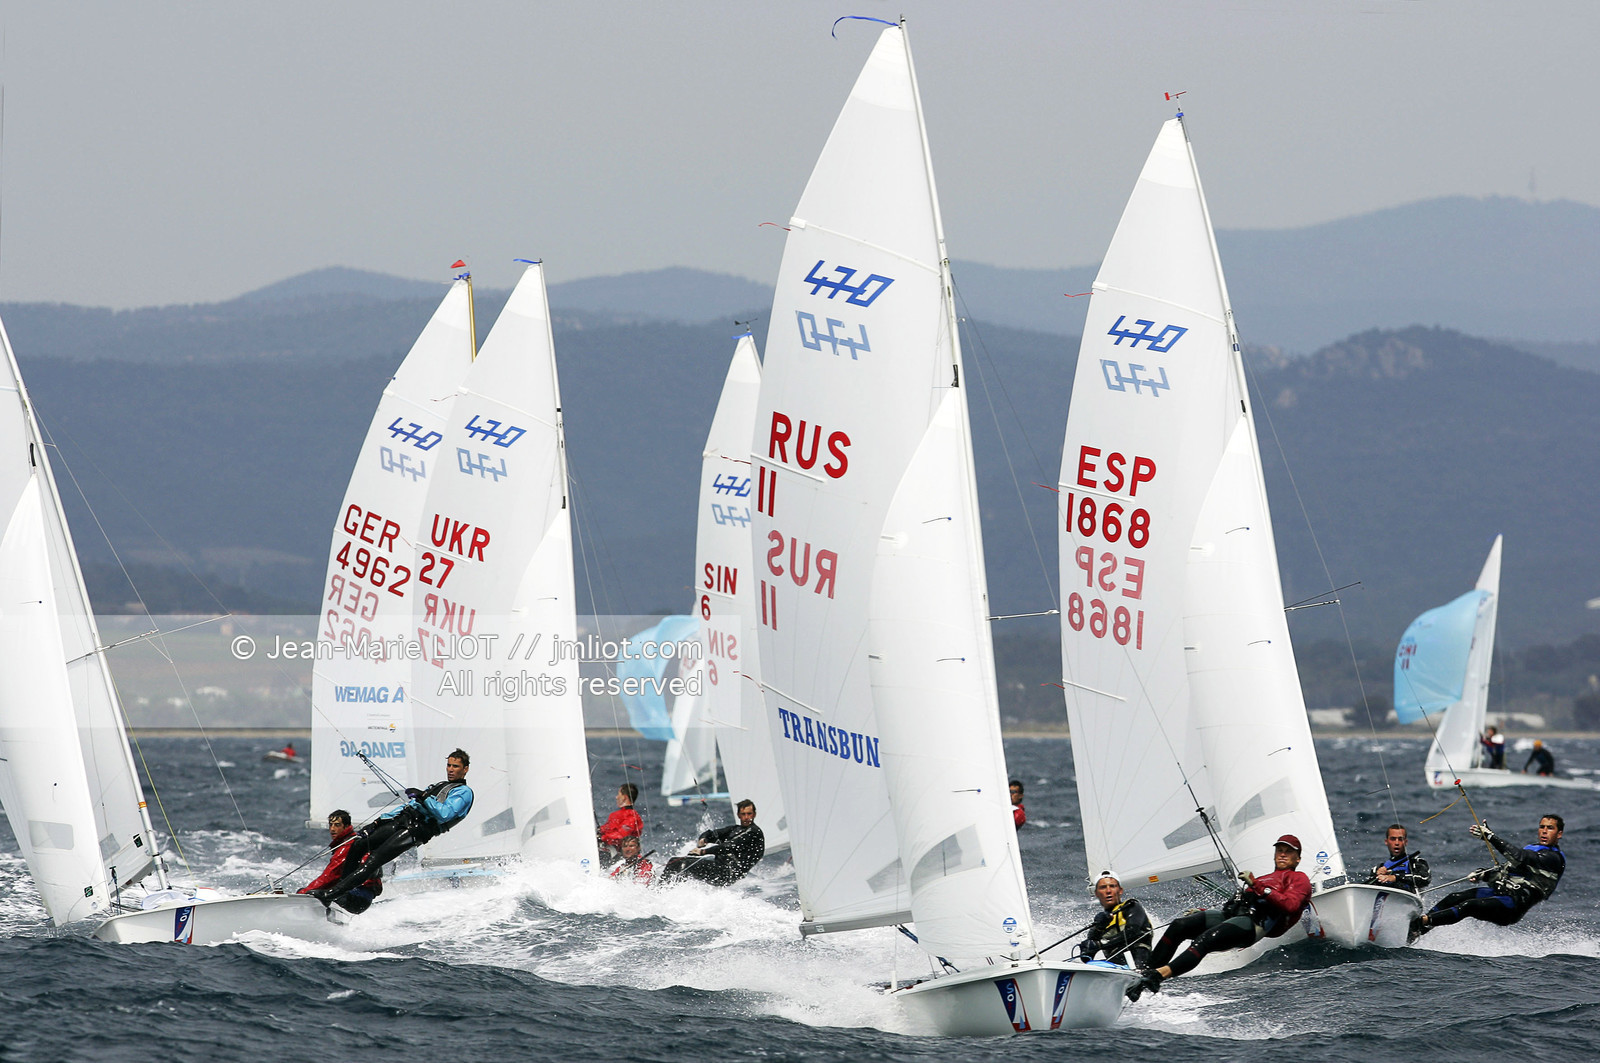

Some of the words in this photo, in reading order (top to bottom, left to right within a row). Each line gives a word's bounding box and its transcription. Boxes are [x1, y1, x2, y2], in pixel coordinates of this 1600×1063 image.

[803, 259, 895, 308] 470
[1107, 315, 1189, 353] 470
[387, 416, 442, 451] 470
[464, 414, 527, 448] 470
[768, 411, 852, 479] RUS
[757, 466, 777, 517] 11
[1077, 445, 1157, 496] ESP
[343, 503, 401, 553] GER
[430, 513, 491, 562] UKR
[1066, 493, 1151, 548] 1868
[336, 541, 411, 597] 4962
[419, 551, 455, 589] 27
[703, 562, 738, 595] SIN
[701, 594, 712, 621] 6
[334, 685, 389, 703] WEMAG
[391, 686, 404, 703] A
[778, 707, 881, 769] TRANSBUN
